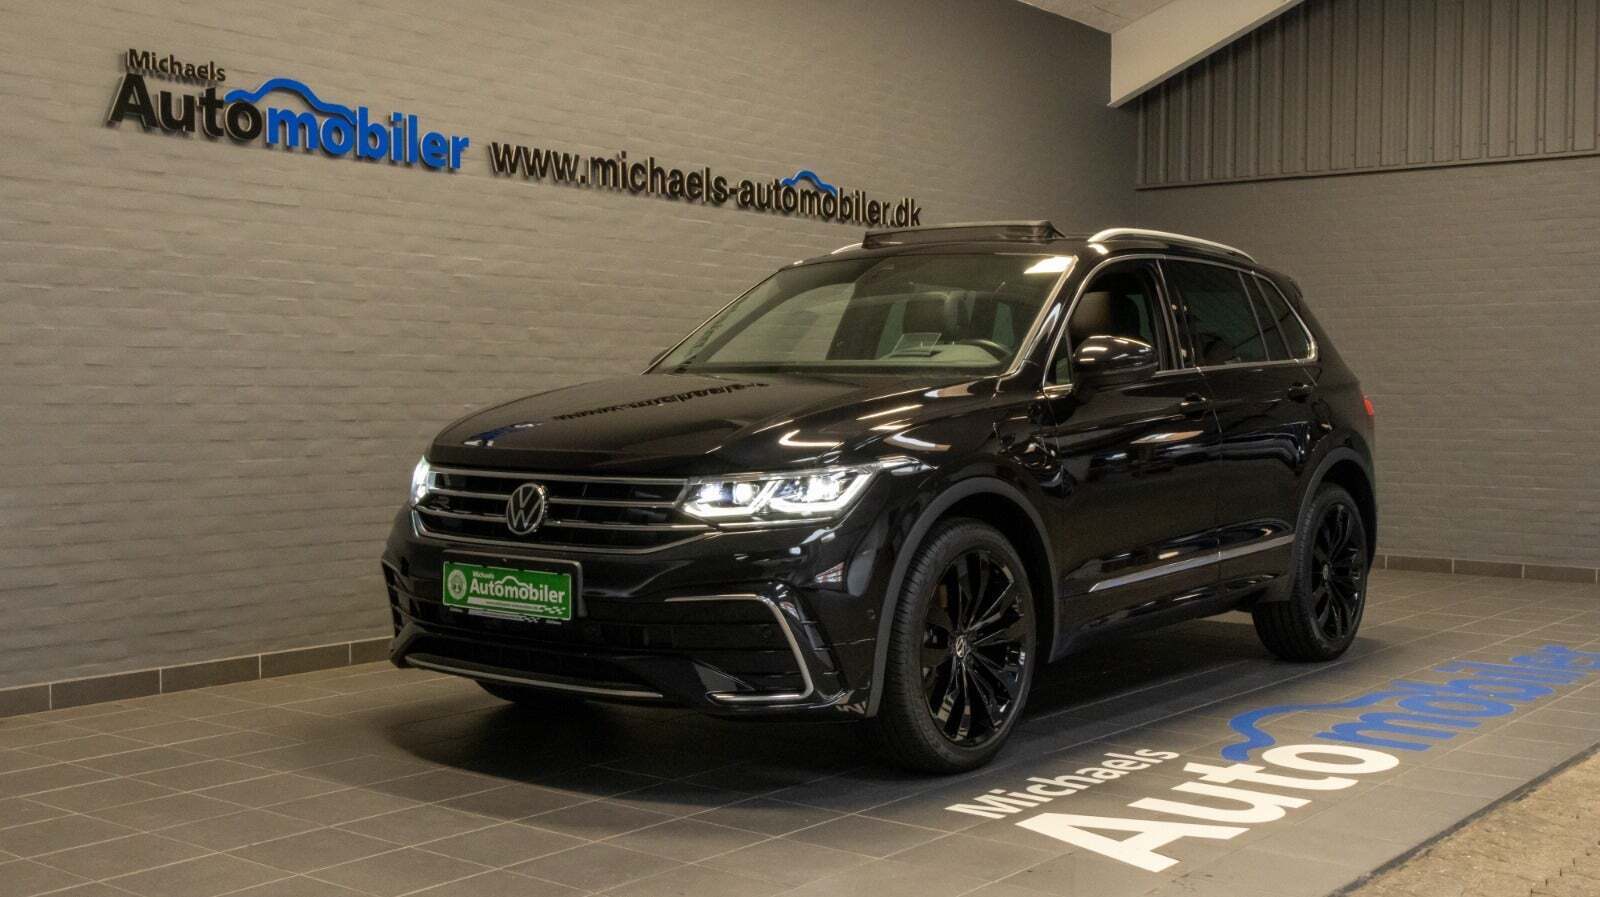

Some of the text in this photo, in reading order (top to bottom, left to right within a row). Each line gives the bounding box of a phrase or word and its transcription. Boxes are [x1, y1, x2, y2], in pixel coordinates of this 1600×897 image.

[126, 48, 226, 82] Michaels
[106, 73, 470, 169] Automobiler
[488, 141, 922, 227] www.michaels-automobiler.dk
[470, 578, 566, 603] Automobiler
[945, 746, 1179, 819] Michaels
